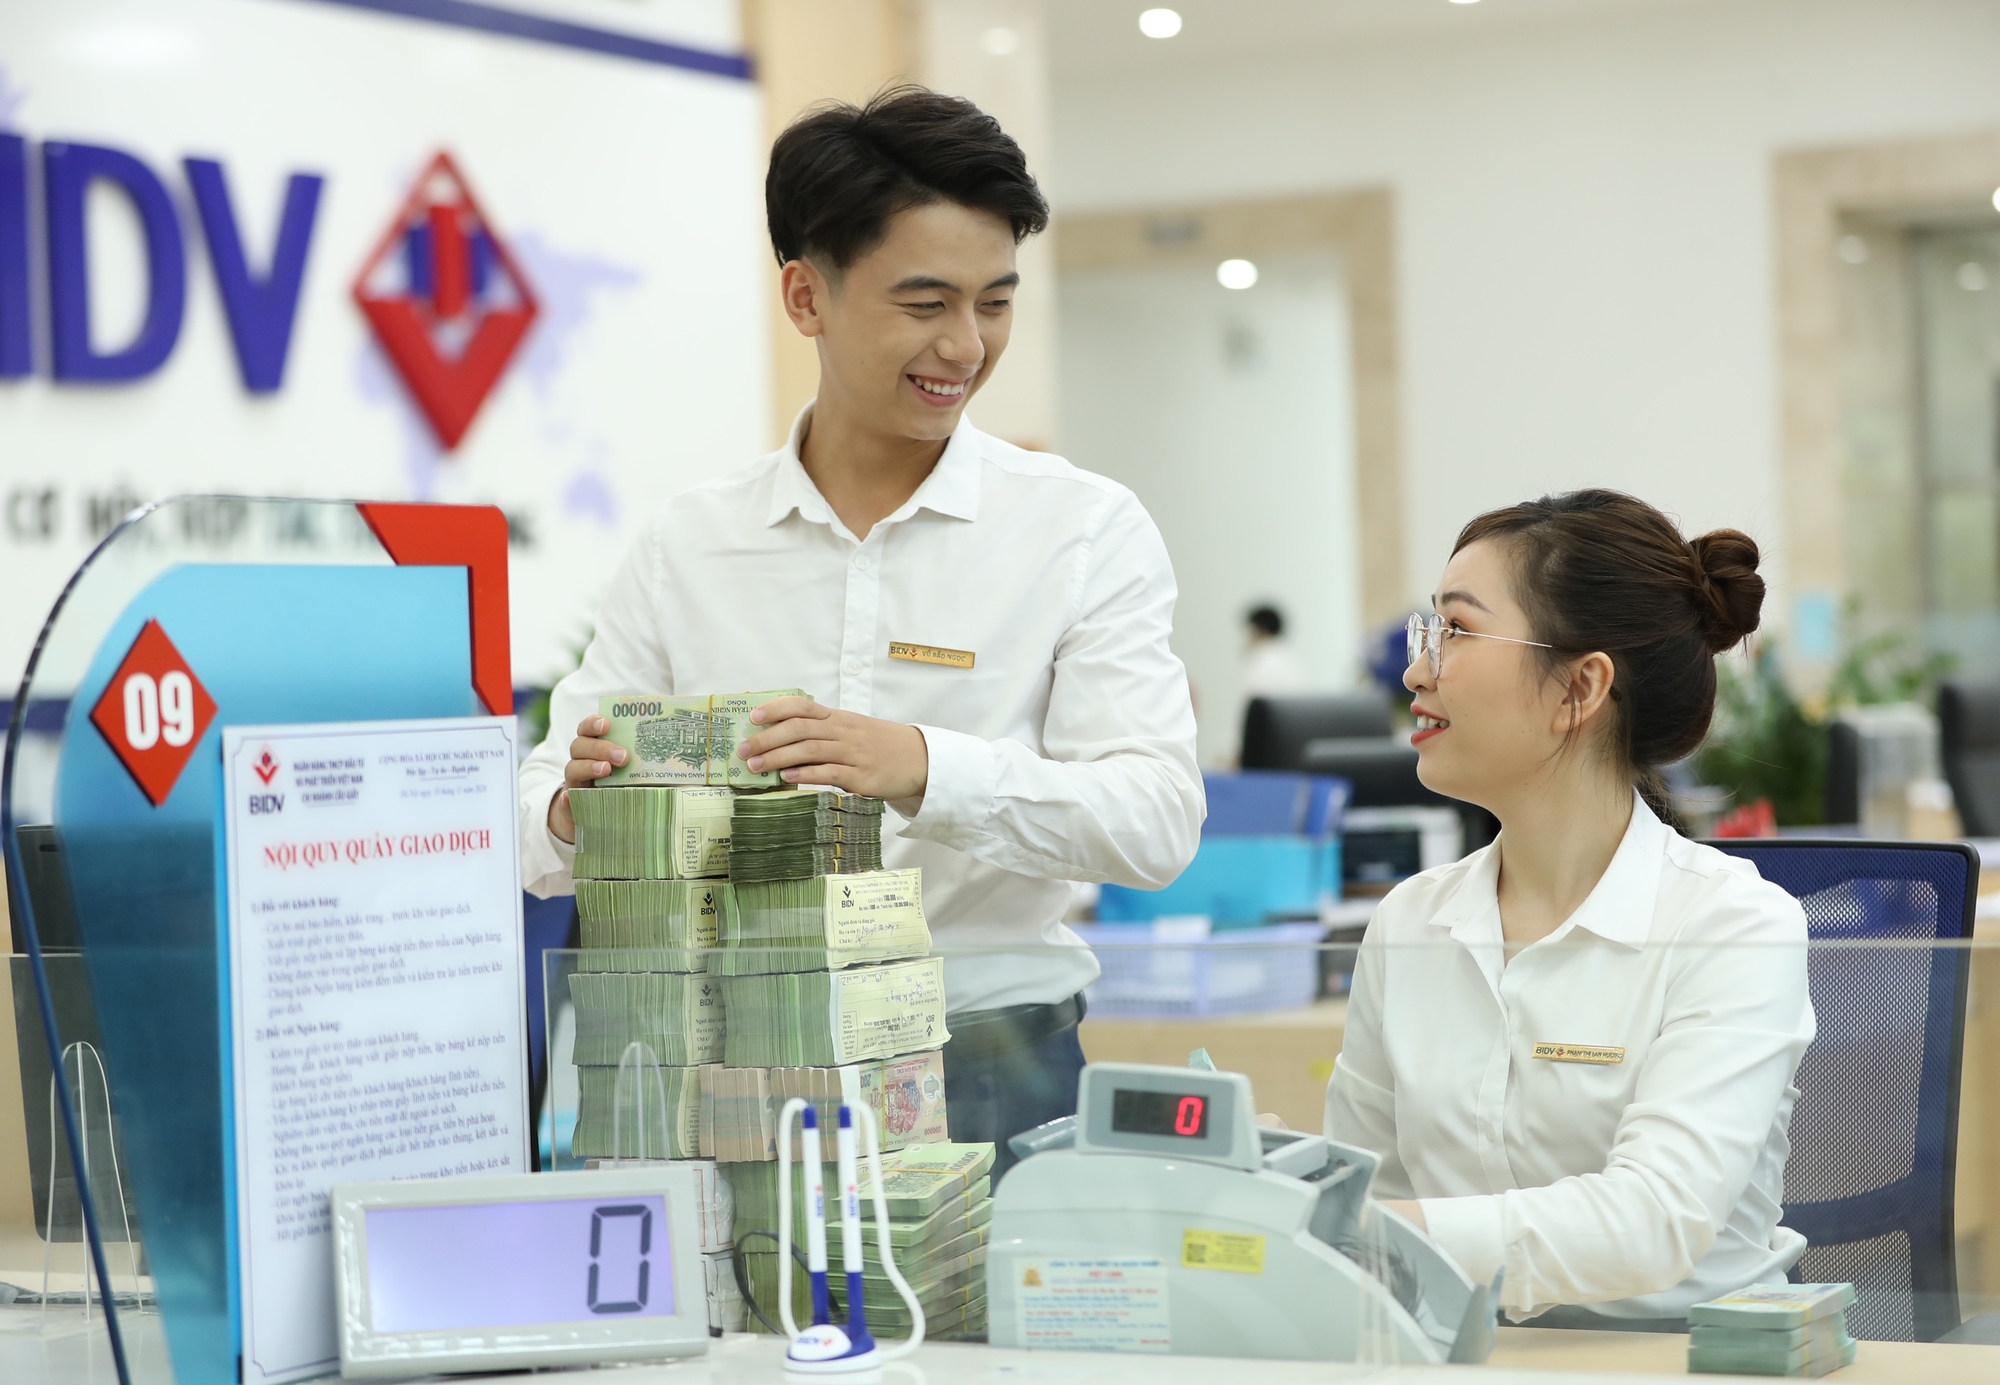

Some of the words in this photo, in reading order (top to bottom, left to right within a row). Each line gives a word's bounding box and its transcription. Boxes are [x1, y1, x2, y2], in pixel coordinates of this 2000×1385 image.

[123, 670, 195, 751] 09
[613, 702, 664, 718] 100.000
[249, 793, 286, 815] BIDV
[264, 842, 298, 871] NỘI
[303, 841, 342, 868] QUY
[400, 832, 445, 857] GIAO
[449, 829, 491, 856] DỊCH
[841, 900, 854, 908] BIDV
[1535, 1047, 1555, 1055] BIDV
[1174, 1096, 1204, 1136] 0
[586, 1204, 653, 1314] 0
